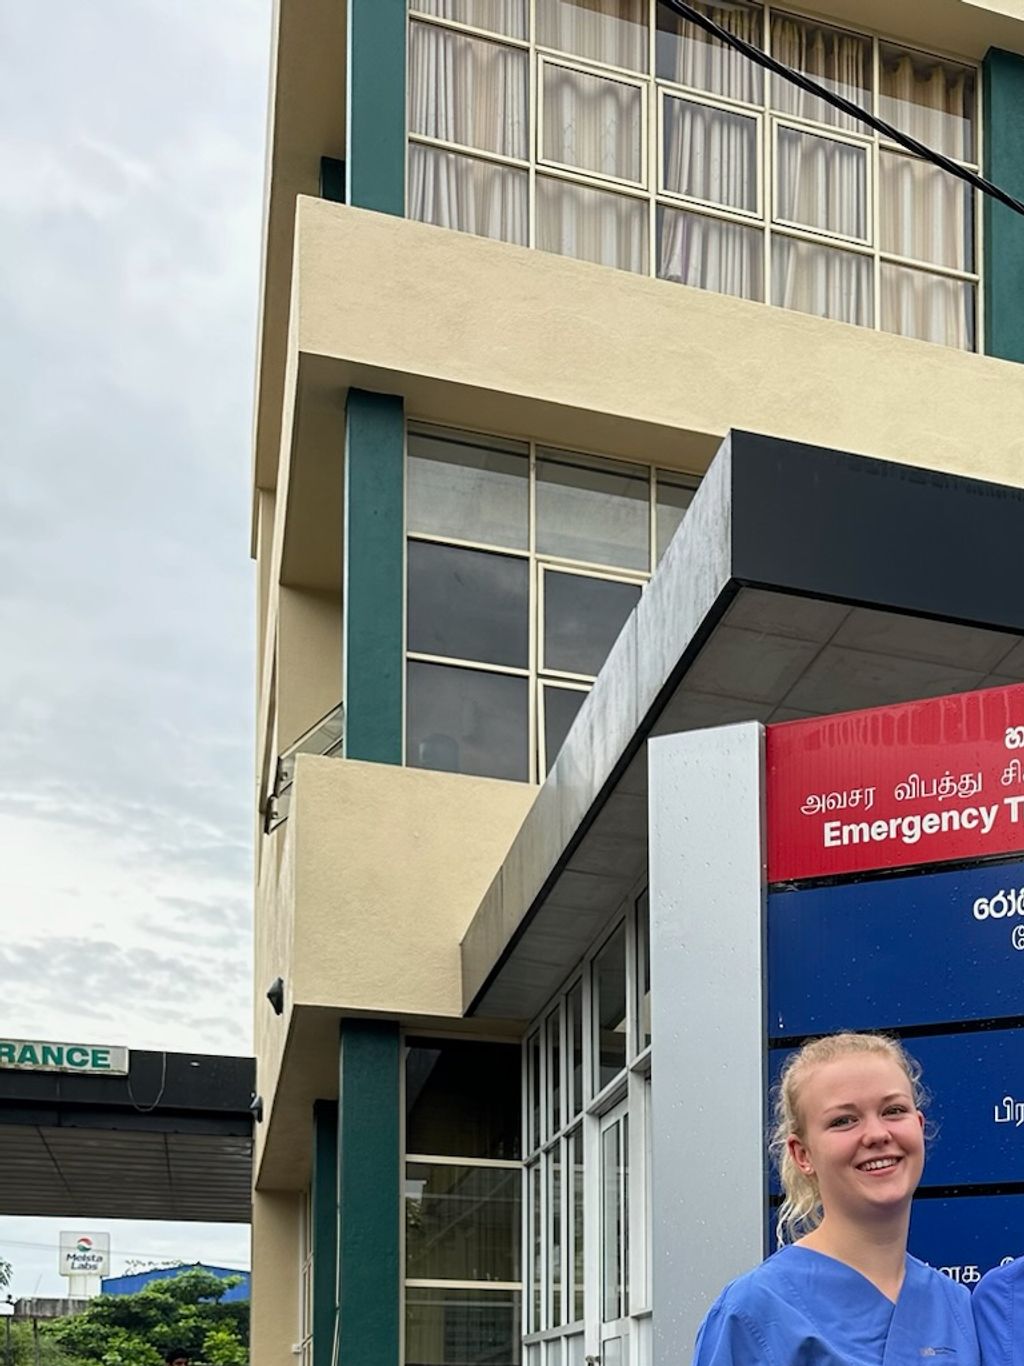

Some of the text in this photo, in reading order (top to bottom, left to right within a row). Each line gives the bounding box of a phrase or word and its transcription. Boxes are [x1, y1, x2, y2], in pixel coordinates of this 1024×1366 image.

[801, 787, 876, 815] அவசர
[894, 770, 983, 801] விபத்து
[824, 804, 999, 848] Emergency
[71, 1262, 98, 1270] Labs
